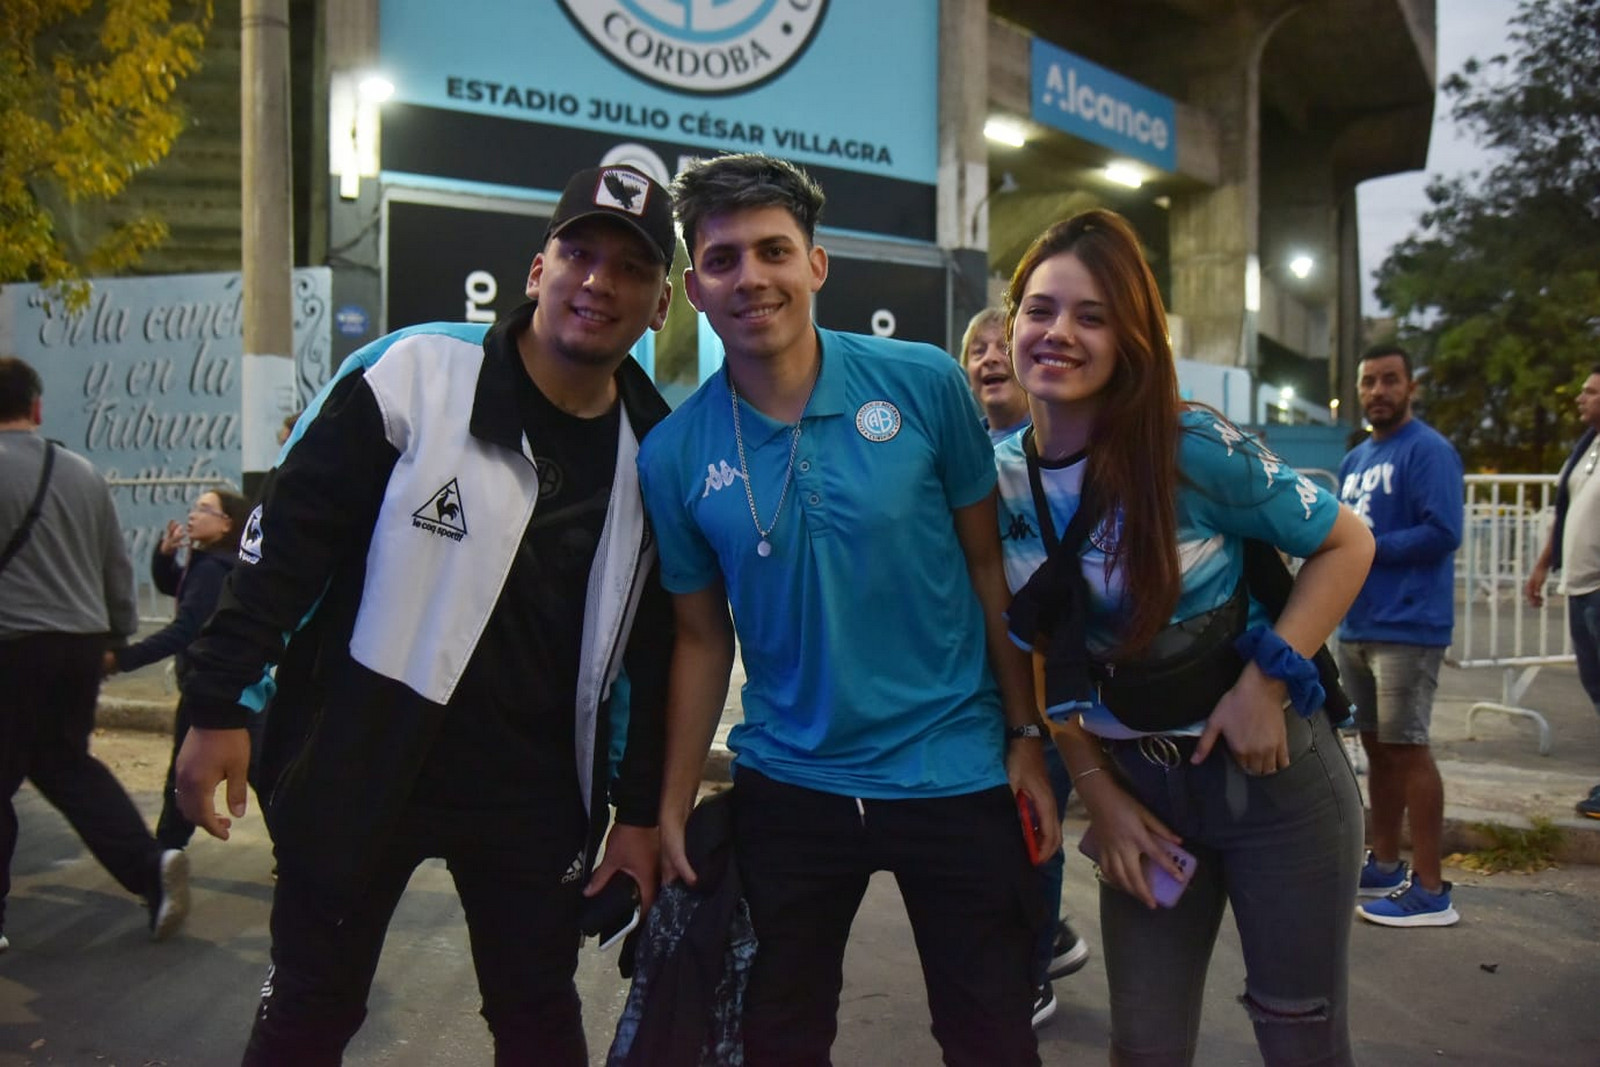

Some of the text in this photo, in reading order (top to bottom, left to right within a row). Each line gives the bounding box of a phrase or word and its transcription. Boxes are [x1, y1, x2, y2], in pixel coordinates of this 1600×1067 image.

[603, 11, 772, 79] CORDOBA
[447, 77, 893, 165] ESTADIO JULIO CÉSAR VILLAGRA
[1043, 64, 1168, 150] Alcance
[93, 290, 131, 344] la
[189, 338, 234, 397] la
